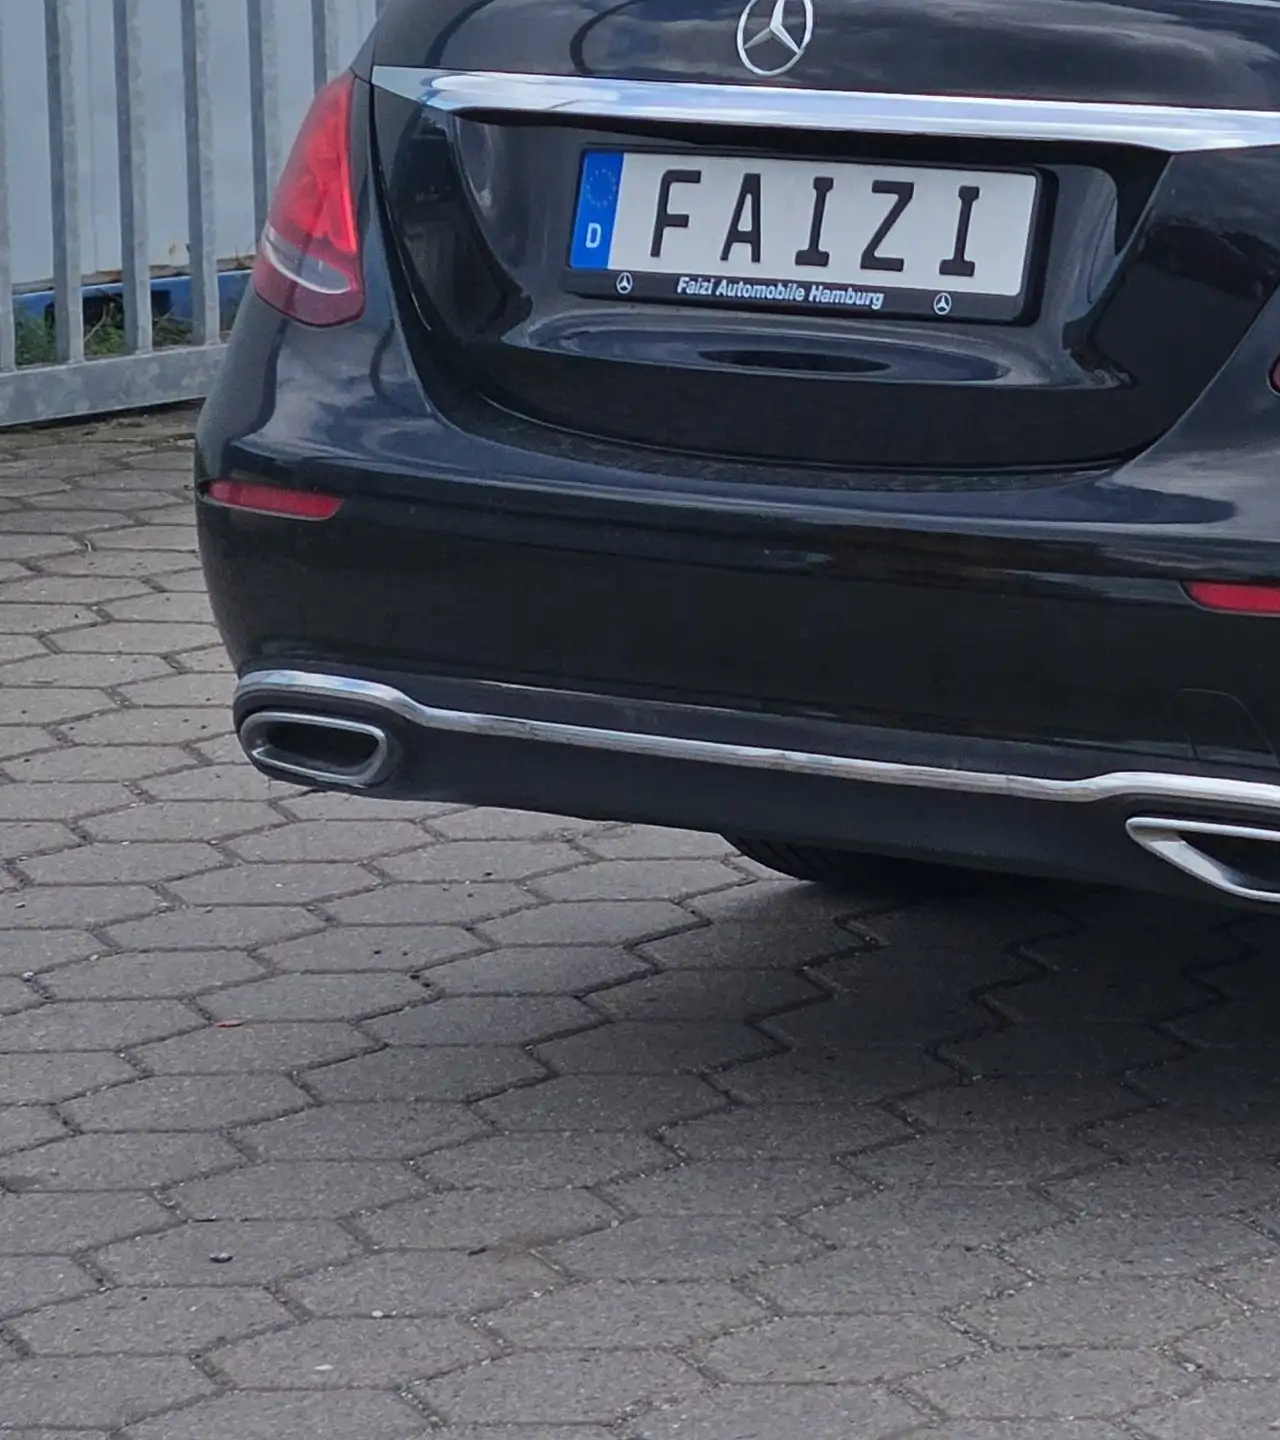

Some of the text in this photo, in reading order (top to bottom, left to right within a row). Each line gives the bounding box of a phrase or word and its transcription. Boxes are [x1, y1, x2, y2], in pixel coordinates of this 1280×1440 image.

[584, 222, 602, 249] D
[650, 168, 981, 277] FAIZI
[676, 276, 885, 310] Faizi Automobile Hamburg
